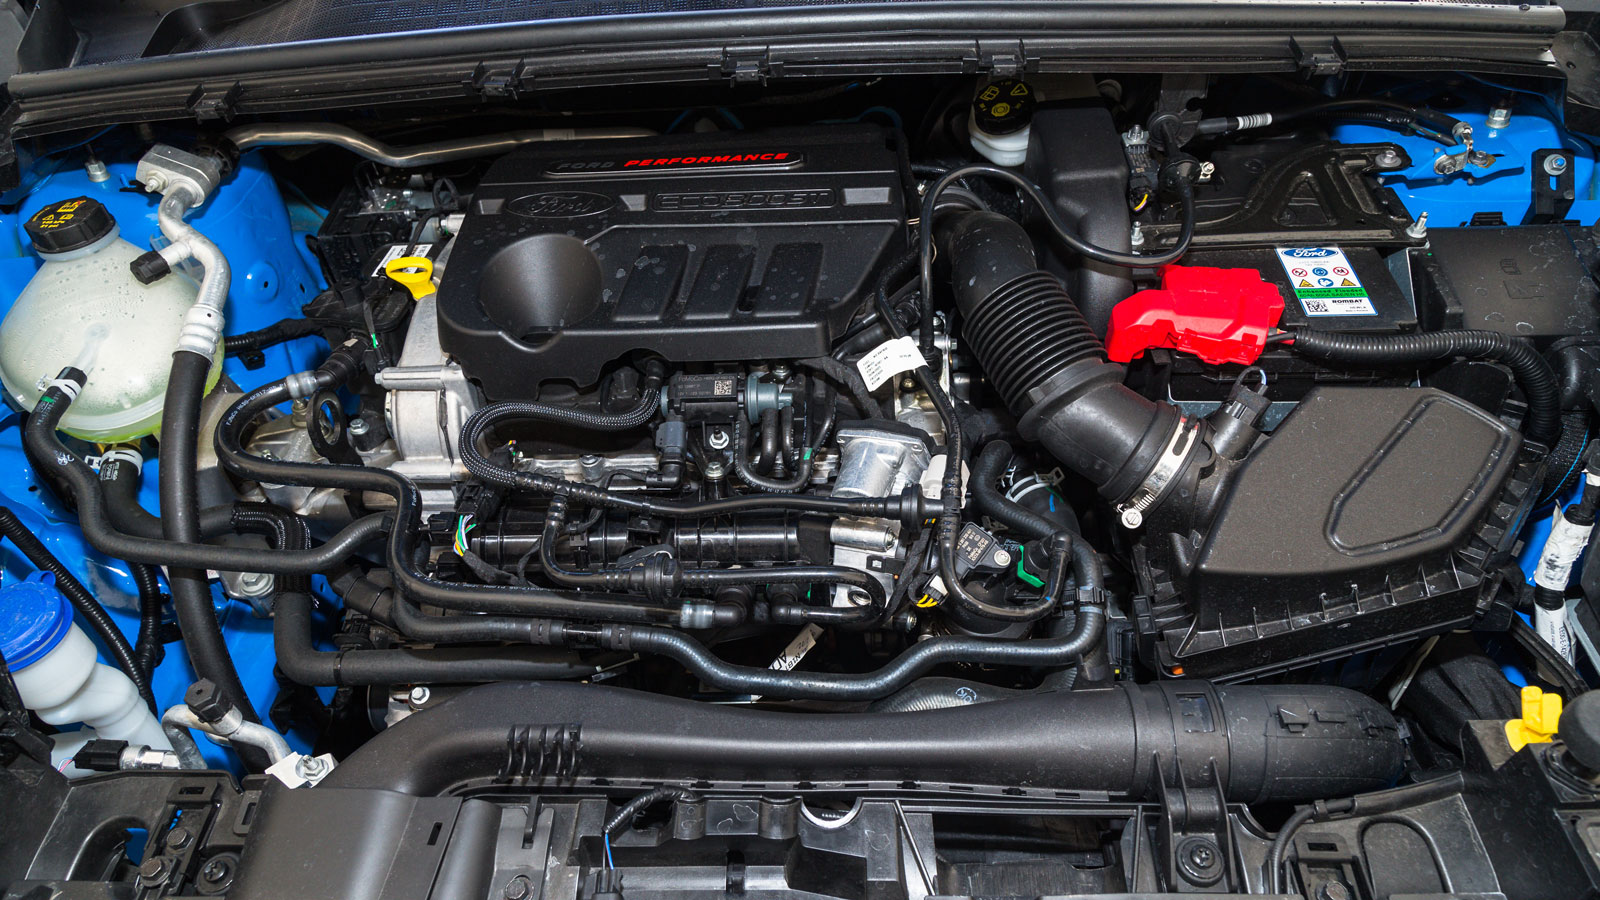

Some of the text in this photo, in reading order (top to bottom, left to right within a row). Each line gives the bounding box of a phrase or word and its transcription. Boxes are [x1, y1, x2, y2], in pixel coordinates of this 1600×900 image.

[557, 152, 789, 170] FORD PERFORMANCE
[528, 195, 593, 216] Ford
[659, 192, 829, 209] ECOBOOST
[1293, 247, 1328, 257] Ford
